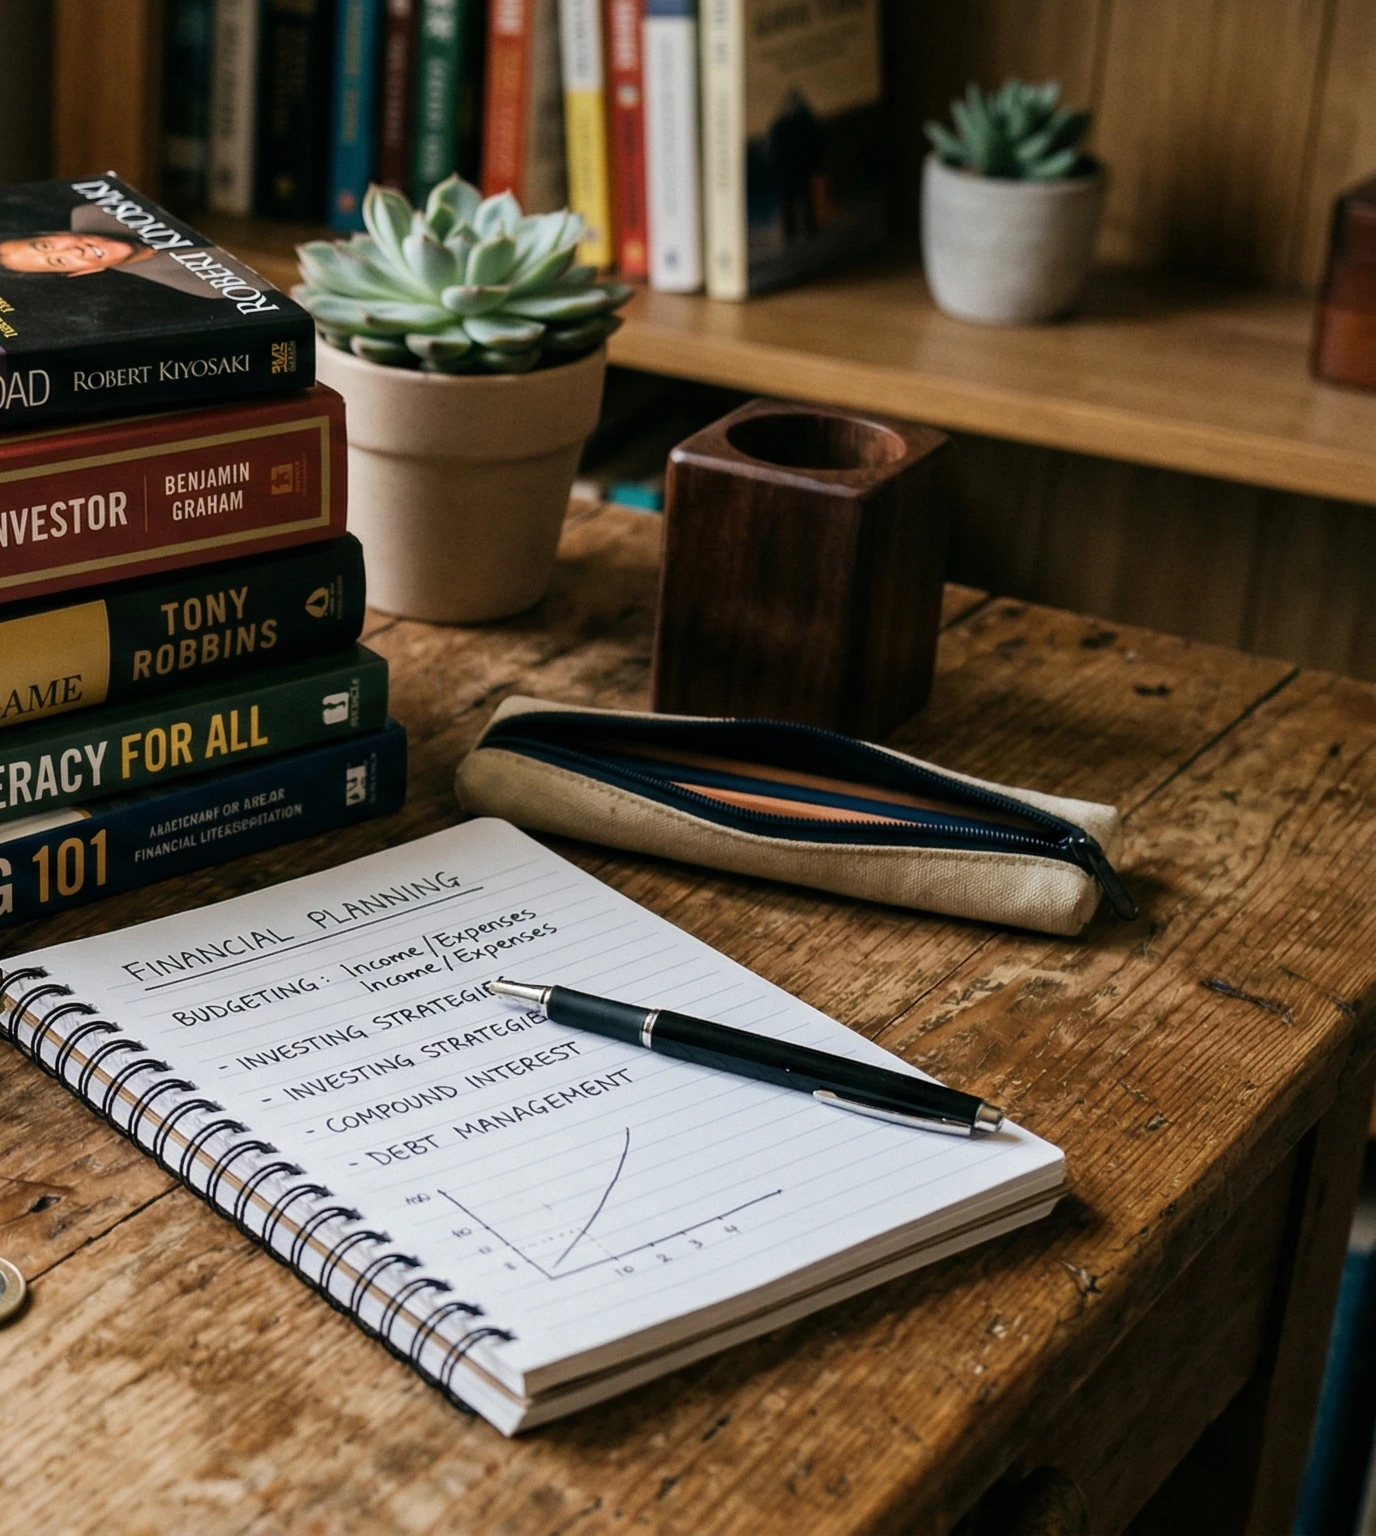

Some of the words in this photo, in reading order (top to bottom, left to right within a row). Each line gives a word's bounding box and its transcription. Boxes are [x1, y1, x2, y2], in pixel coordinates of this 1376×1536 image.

[71, 180, 194, 250] KIYOSAKI
[167, 251, 280, 316] ROBERT
[73, 366, 152, 391] ROBERT
[159, 354, 250, 382] KIYOSAKI
[165, 462, 250, 495] BENJAMIN
[172, 490, 244, 521] GRAHAM
[161, 586, 248, 636] TONY
[132, 619, 278, 681] ROBBINS
[121, 721, 193, 780] FOR
[206, 704, 269, 759] ALL
[223, 801, 240, 817] OR
[32, 828, 107, 903] 101
[134, 836, 197, 863] FINANCIAL
[122, 928, 295, 981] FINANCIAL
[307, 871, 461, 929] PLANNING
[235, 1024, 369, 1070] INVESTING
[372, 976, 505, 1030] STRATEGIE
[282, 1054, 416, 1101] INVESTING
[326, 1084, 458, 1133] COMPOUND
[464, 1040, 582, 1089] INTEREST
[364, 1134, 440, 1166] DEBT
[452, 1067, 633, 1140] MANAGEMENT
[656, 1253, 673, 1263] 2
